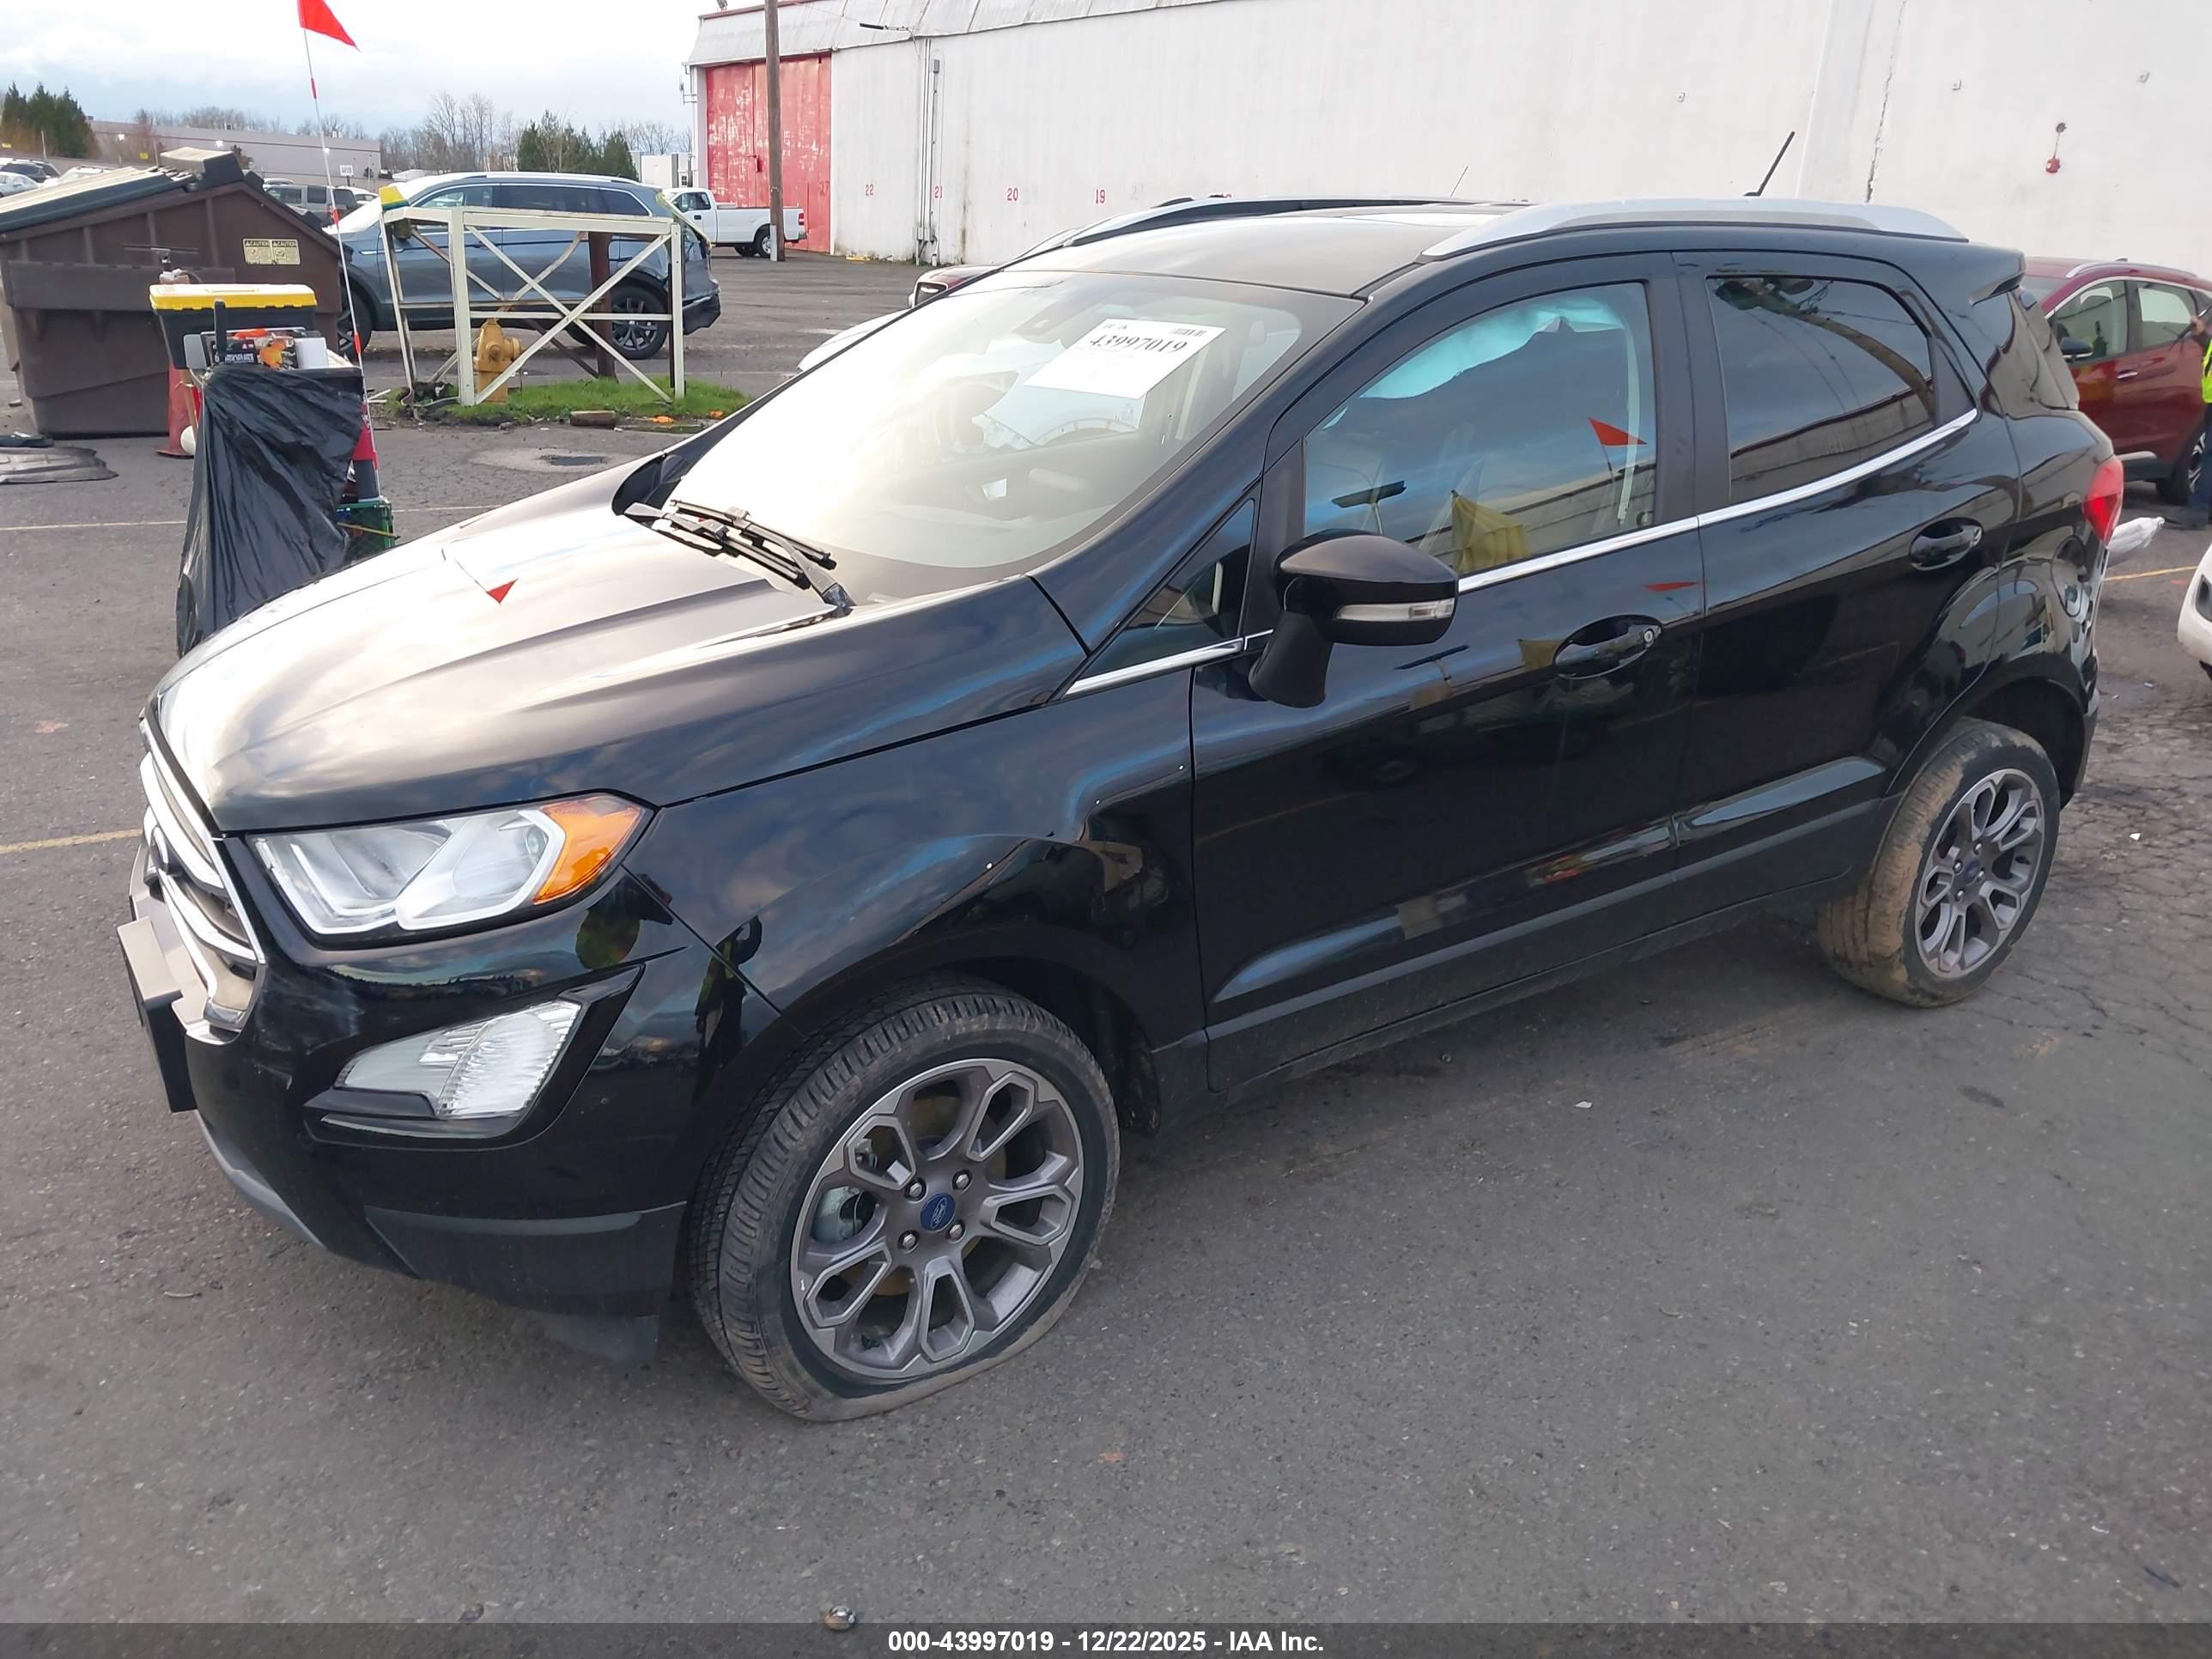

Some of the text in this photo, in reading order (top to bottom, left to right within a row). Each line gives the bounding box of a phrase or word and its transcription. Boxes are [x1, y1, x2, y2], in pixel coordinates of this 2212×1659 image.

[866, 184, 874, 197] 22
[1006, 186, 1019, 202] 20
[1095, 188, 1107, 205] 19
[1090, 335, 1188, 353] 43997019
